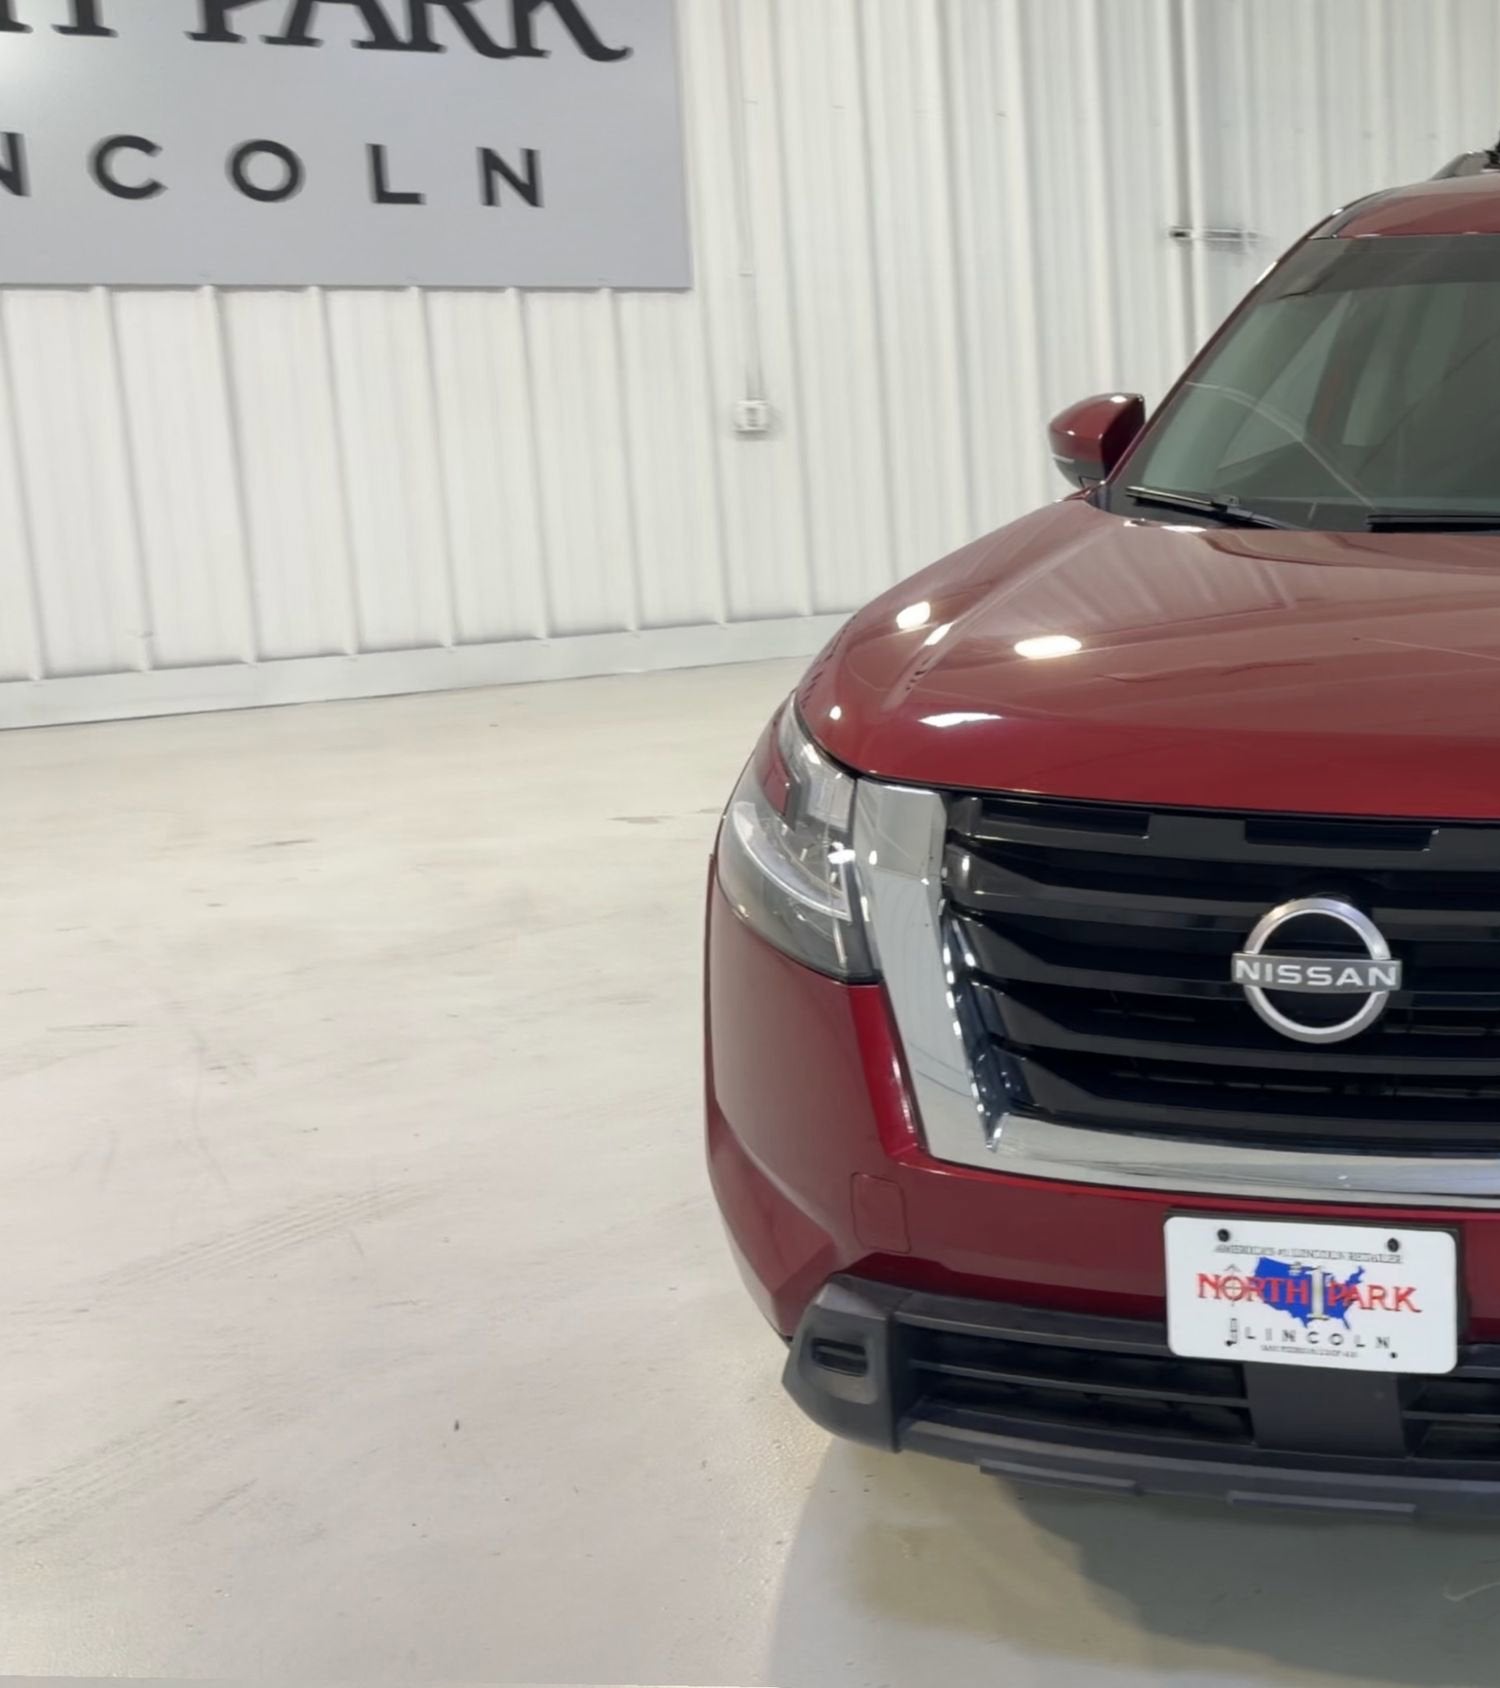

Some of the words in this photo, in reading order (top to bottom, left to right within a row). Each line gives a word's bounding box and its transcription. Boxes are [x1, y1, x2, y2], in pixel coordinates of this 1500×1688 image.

[1235, 959, 1397, 987] NISSAN
[1197, 1273, 1309, 1304] NORTH
[1329, 1281, 1422, 1313] PARK
[1244, 1326, 1390, 1349] LINCOLN
